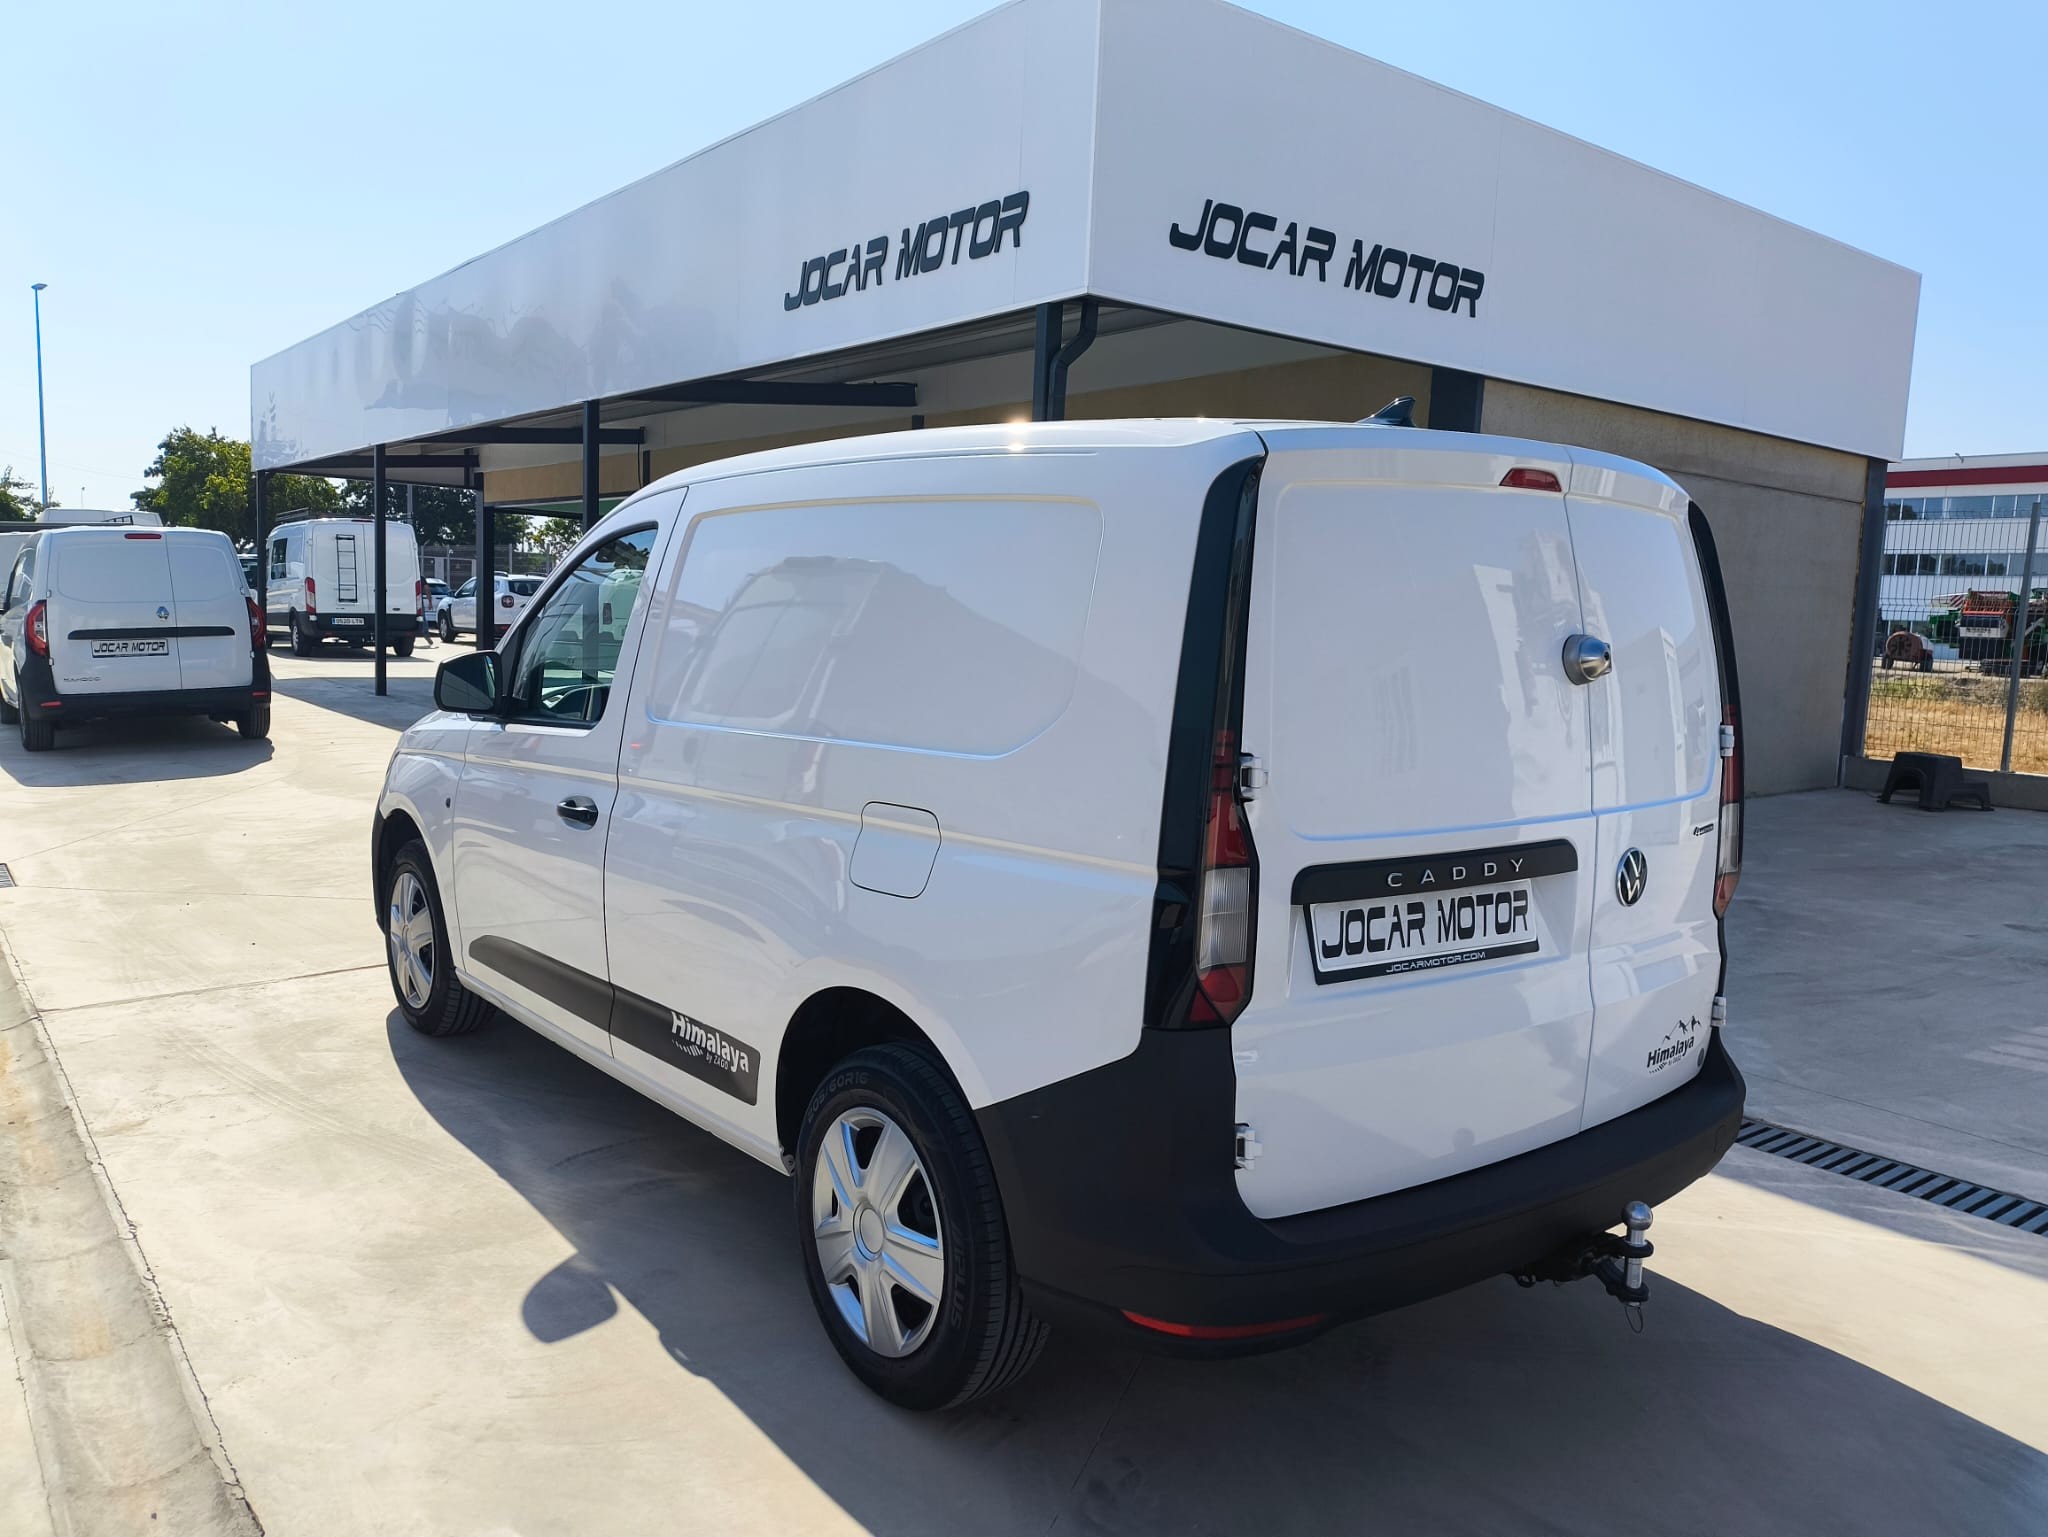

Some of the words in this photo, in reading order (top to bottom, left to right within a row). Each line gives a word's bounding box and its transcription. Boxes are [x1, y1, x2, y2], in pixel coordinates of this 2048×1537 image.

[784, 236, 889, 311] JOCAR
[895, 190, 1030, 280] MOTOR
[1169, 199, 1337, 282] JOCAR
[1344, 239, 1485, 318] MOTOR
[94, 642, 128, 653] JOCAR
[132, 641, 166, 652] MOTOR
[1386, 857, 1524, 888] CADDY
[1321, 901, 1426, 959] JOCAR
[1437, 889, 1529, 944] MOTOR
[1386, 951, 1487, 974] JOCARMOTOR.COM
[671, 1011, 749, 1073] Himalaya
[1646, 1035, 1695, 1069] Himalaya
